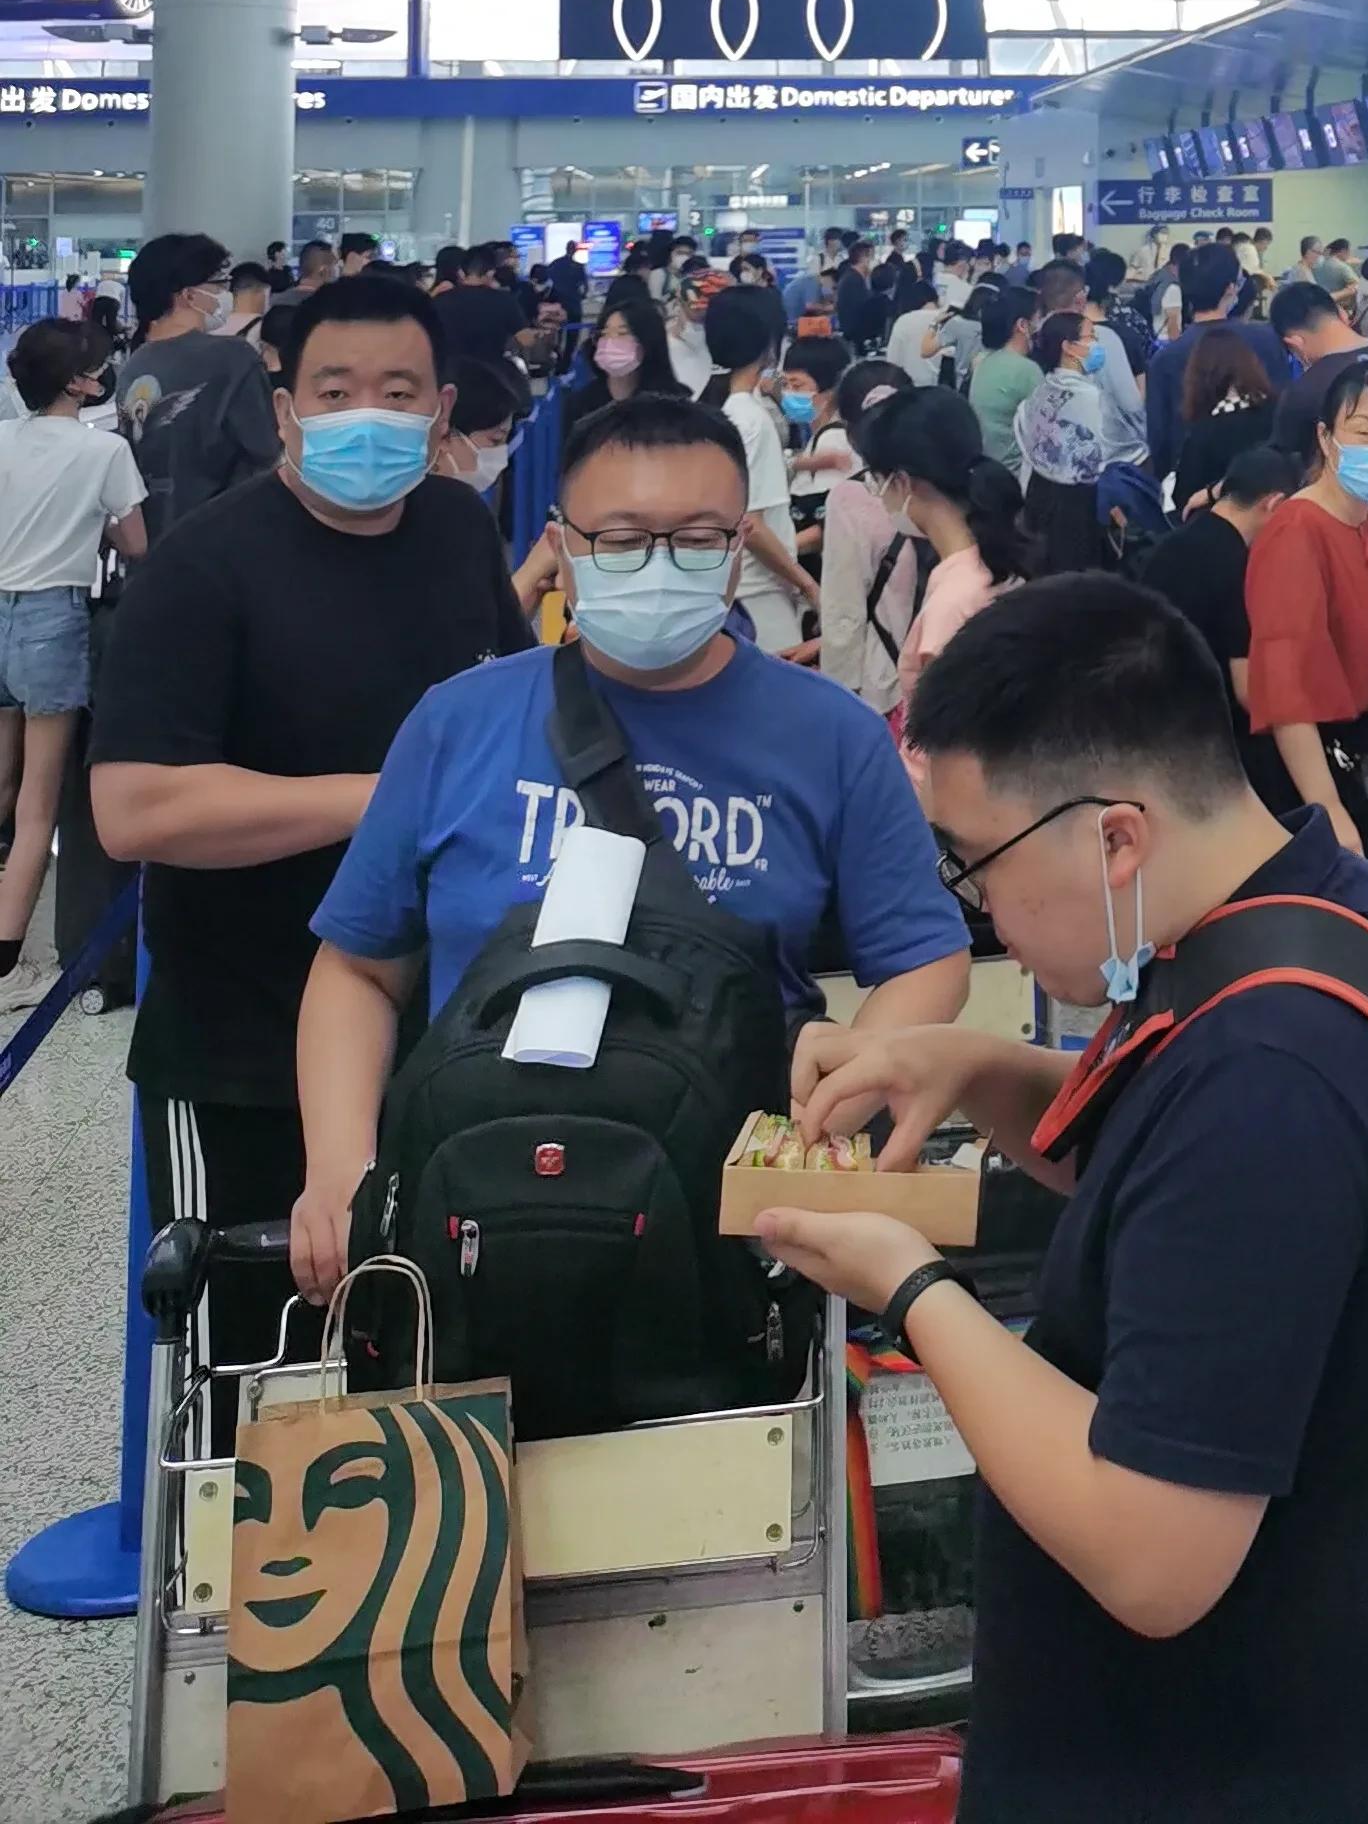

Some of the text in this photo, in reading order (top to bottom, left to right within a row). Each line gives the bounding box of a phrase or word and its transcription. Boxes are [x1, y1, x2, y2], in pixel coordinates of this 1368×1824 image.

[61, 88, 150, 112] Domes
[671, 84, 778, 110] 国内出发
[781, 86, 887, 108] Domestic
[1190, 207, 1225, 218] Check
[1226, 207, 1260, 218] Room
[643, 779, 677, 792] WEAR
